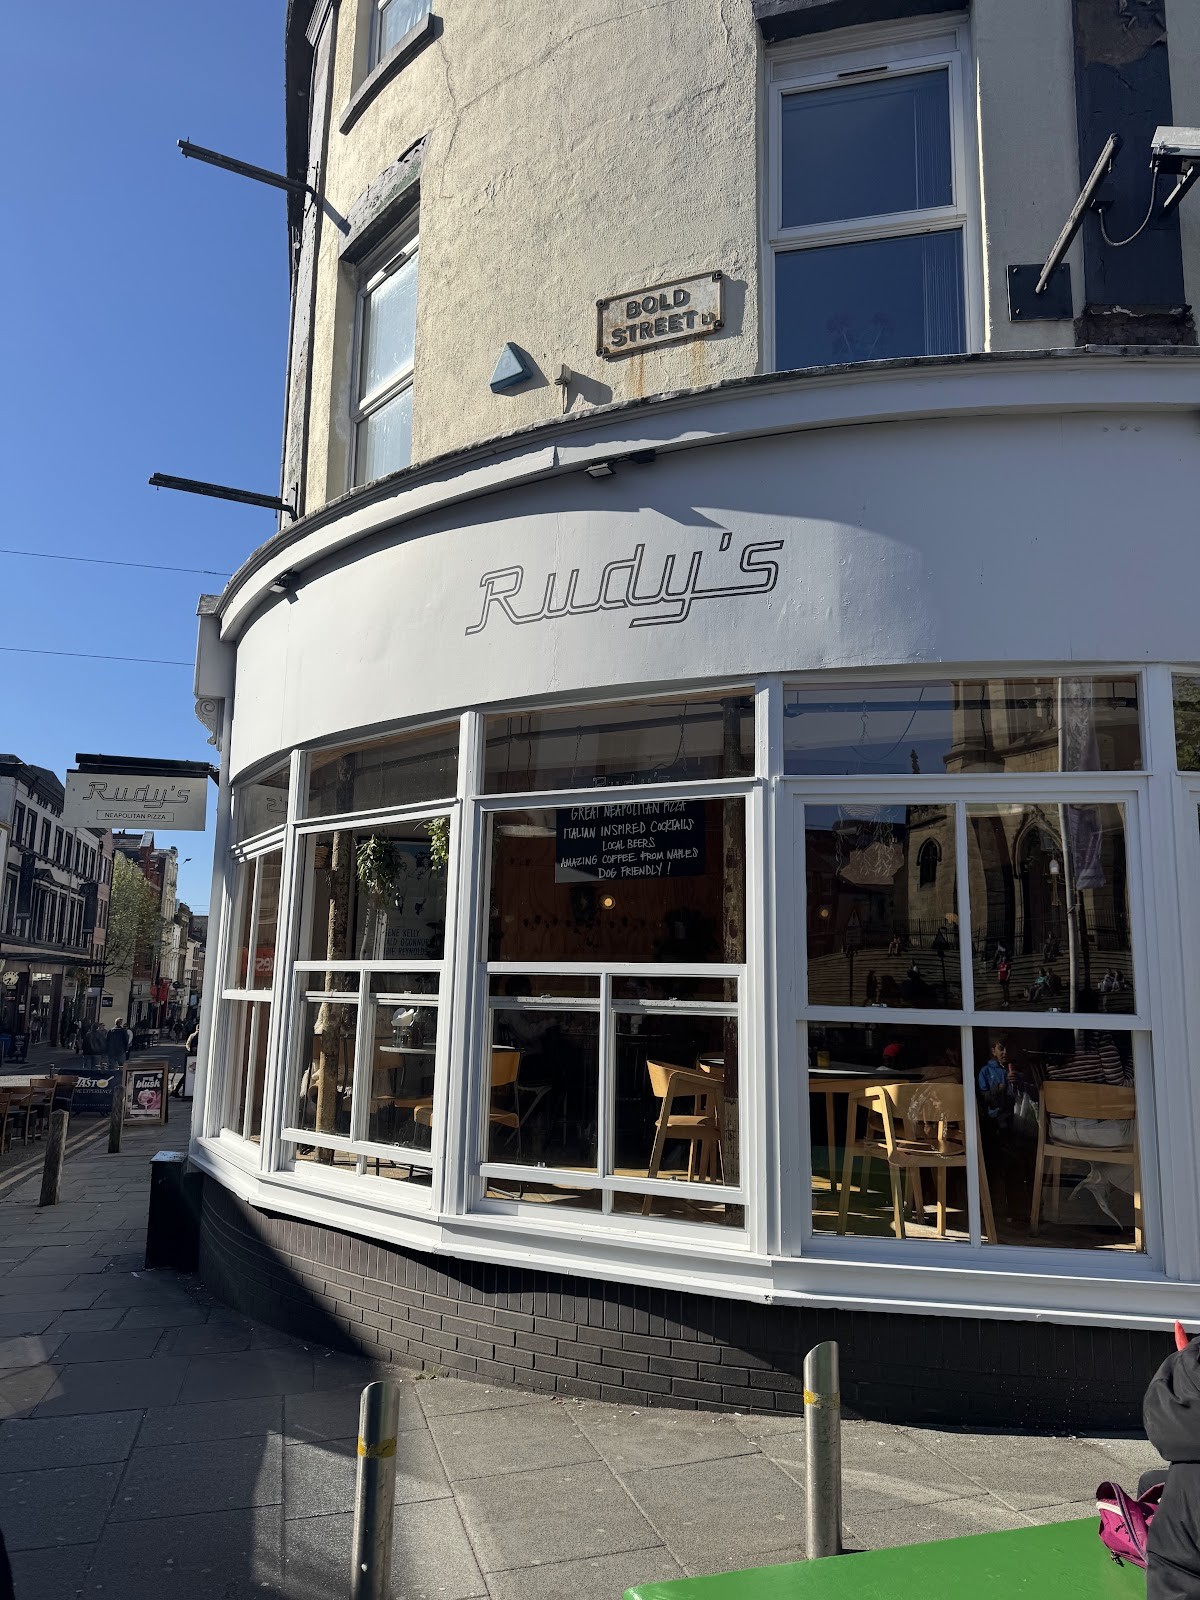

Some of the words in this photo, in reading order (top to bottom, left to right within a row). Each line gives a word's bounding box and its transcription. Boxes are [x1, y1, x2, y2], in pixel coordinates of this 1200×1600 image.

[626, 289, 691, 319] BOLD
[611, 310, 698, 347] STREET
[465, 532, 785, 635] Rudy's
[82, 782, 191, 808] Rudy's
[104, 812, 147, 820] NEAPOLITAN
[147, 813, 166, 821] PIZZA
[563, 827, 596, 840] ITALIAN
[600, 821, 646, 837] INSPIRED
[650, 818, 694, 833] COCKTAILS
[602, 840, 625, 852] LOCAL
[627, 837, 656, 849] BEERS
[560, 855, 598, 868] AMAZING
[602, 852, 637, 864] COFFEE
[640, 851, 664, 862] FROM
[666, 847, 699, 860] NAPLES
[598, 867, 617, 879] DOG
[621, 862, 663, 877] FRIENDLY
[403, 929, 420, 938] KELLY
[136, 1077, 161, 1089] blush
